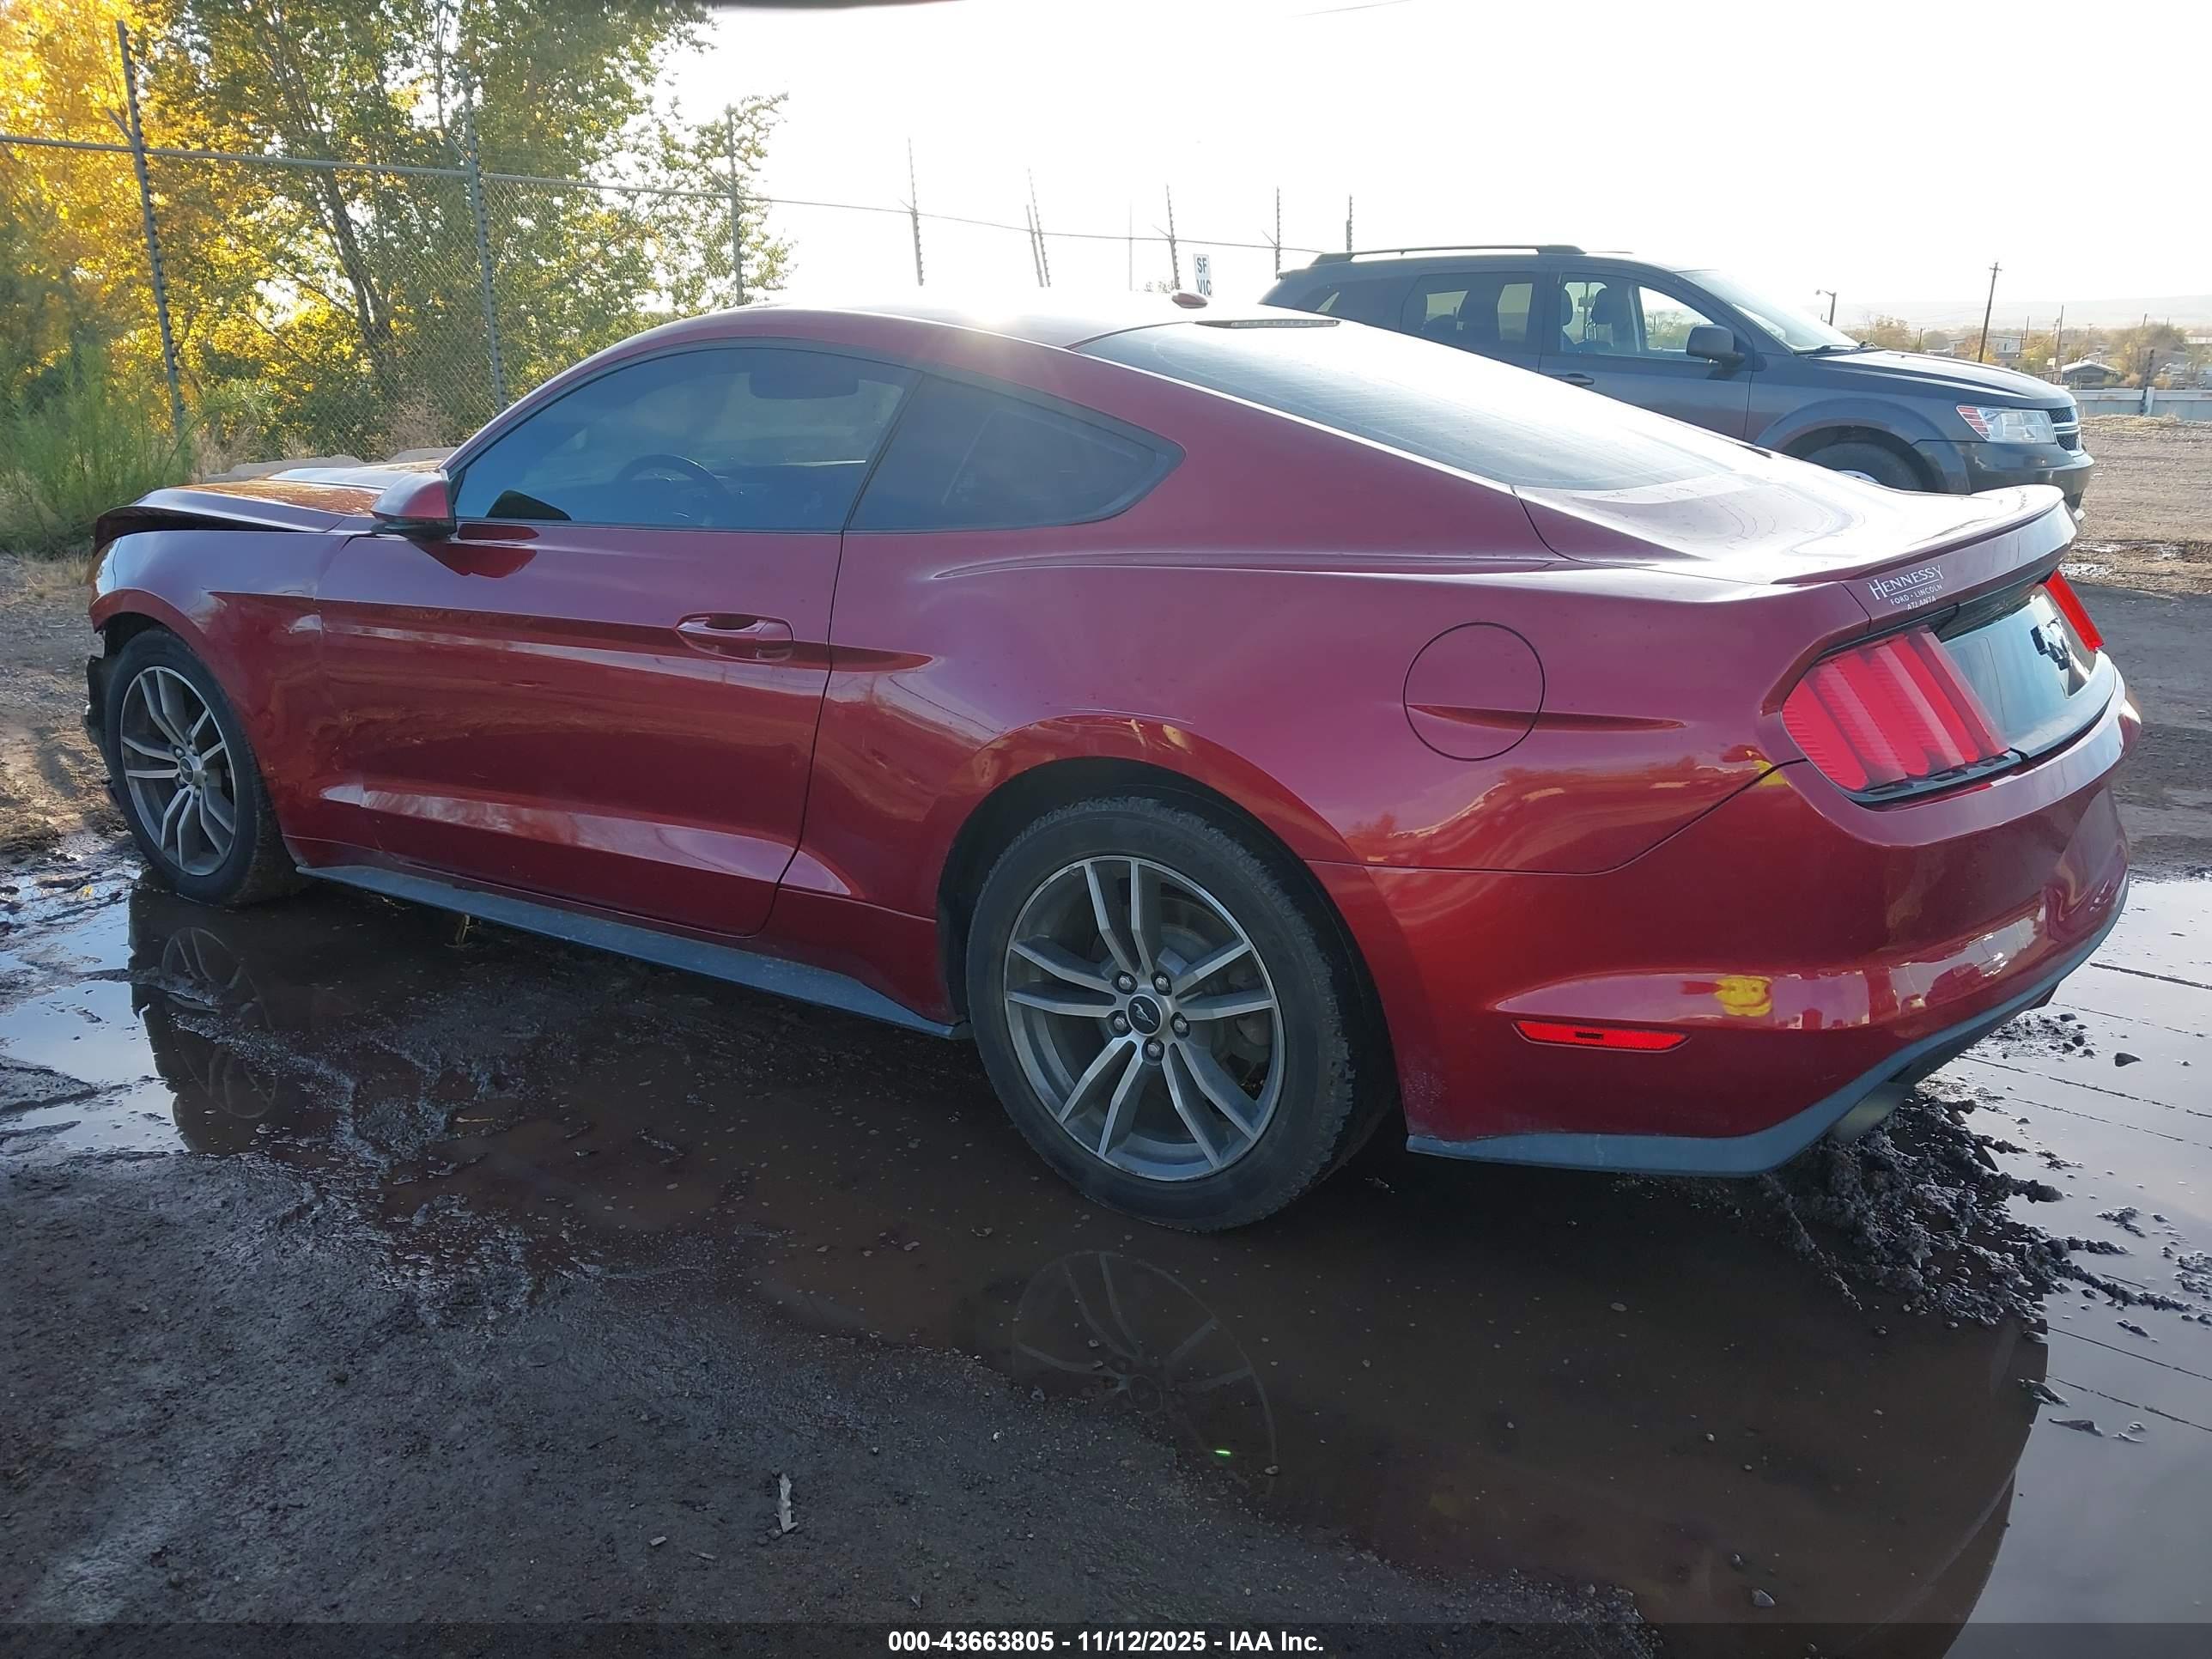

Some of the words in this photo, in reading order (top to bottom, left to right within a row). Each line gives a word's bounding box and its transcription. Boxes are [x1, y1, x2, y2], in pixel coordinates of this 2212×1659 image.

[1867, 563, 1945, 600] HENNESSY
[1890, 594, 1910, 605] FORD
[1914, 584, 1942, 598] LINCOLN
[1906, 596, 1936, 611] ATLANTA
